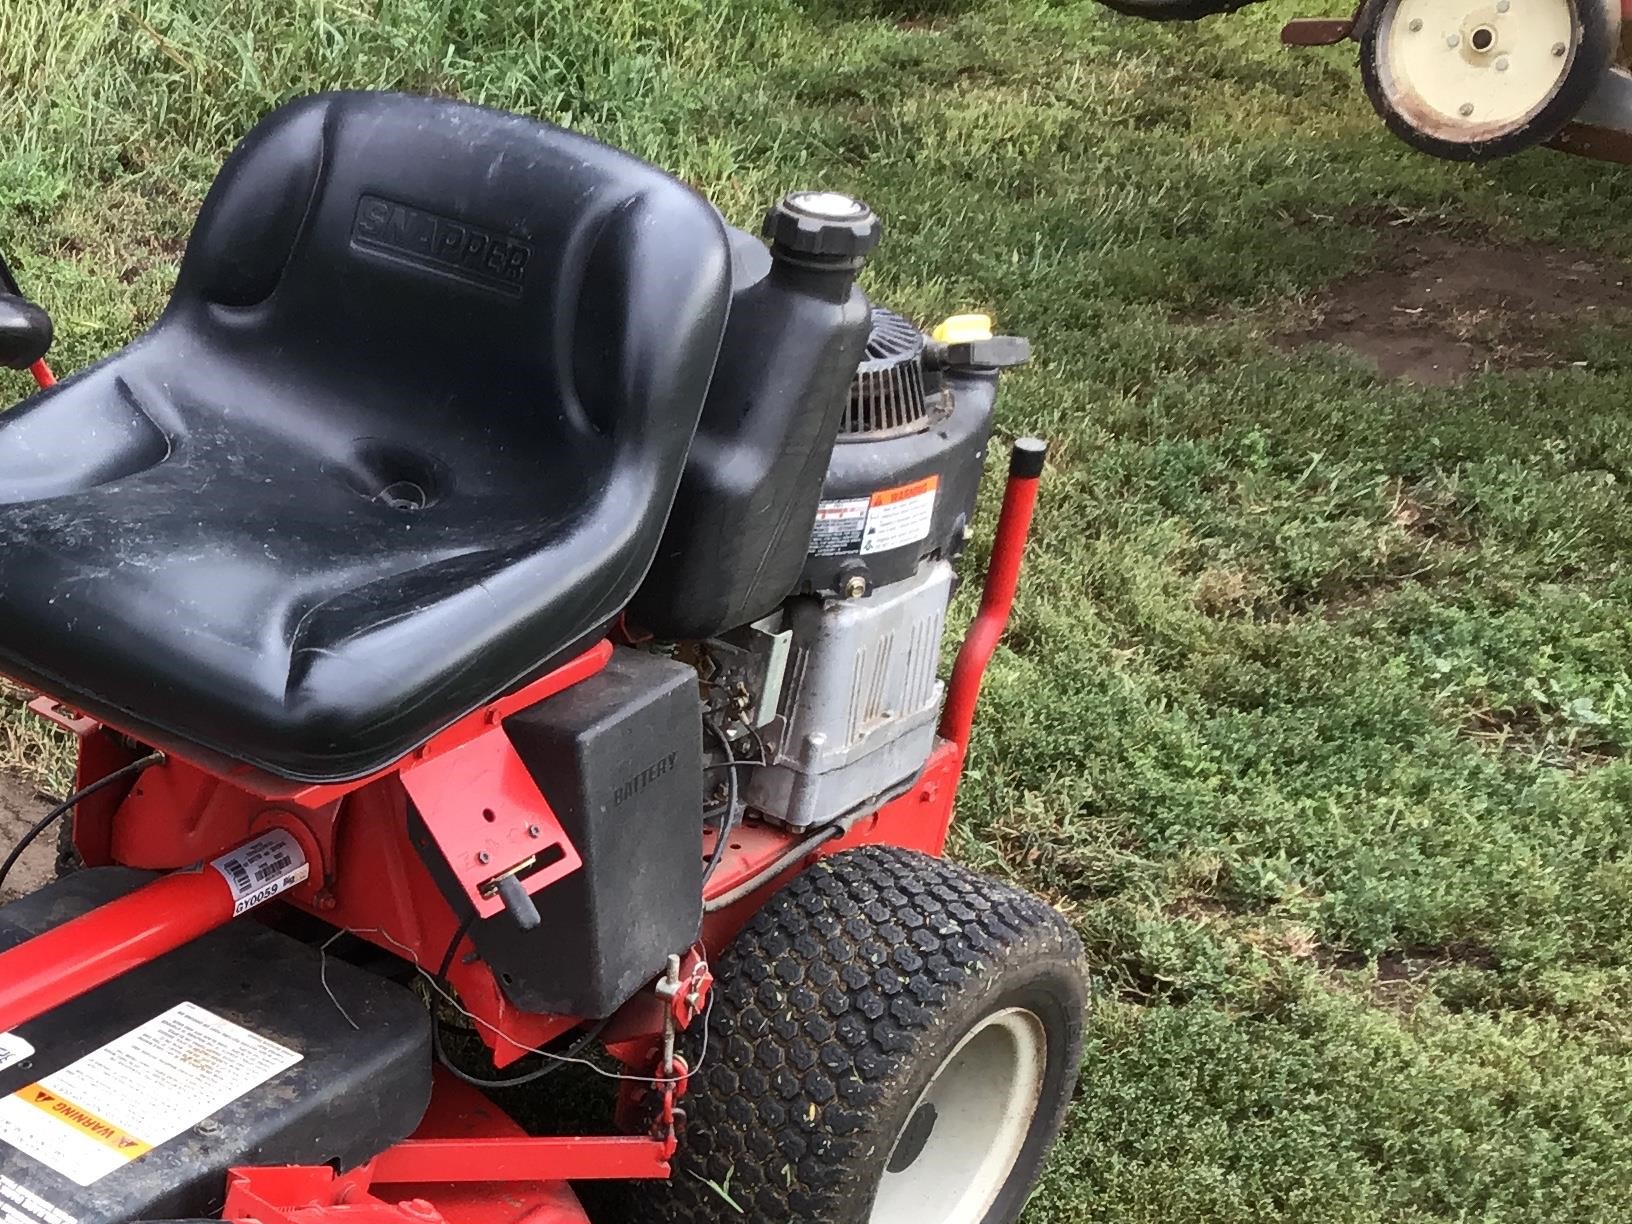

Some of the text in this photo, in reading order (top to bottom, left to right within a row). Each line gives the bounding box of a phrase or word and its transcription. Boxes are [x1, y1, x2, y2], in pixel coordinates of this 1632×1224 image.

[613, 751, 678, 806] BATTERY
[235, 884, 278, 913] GY0059
[52, 1101, 117, 1138] WARNING
